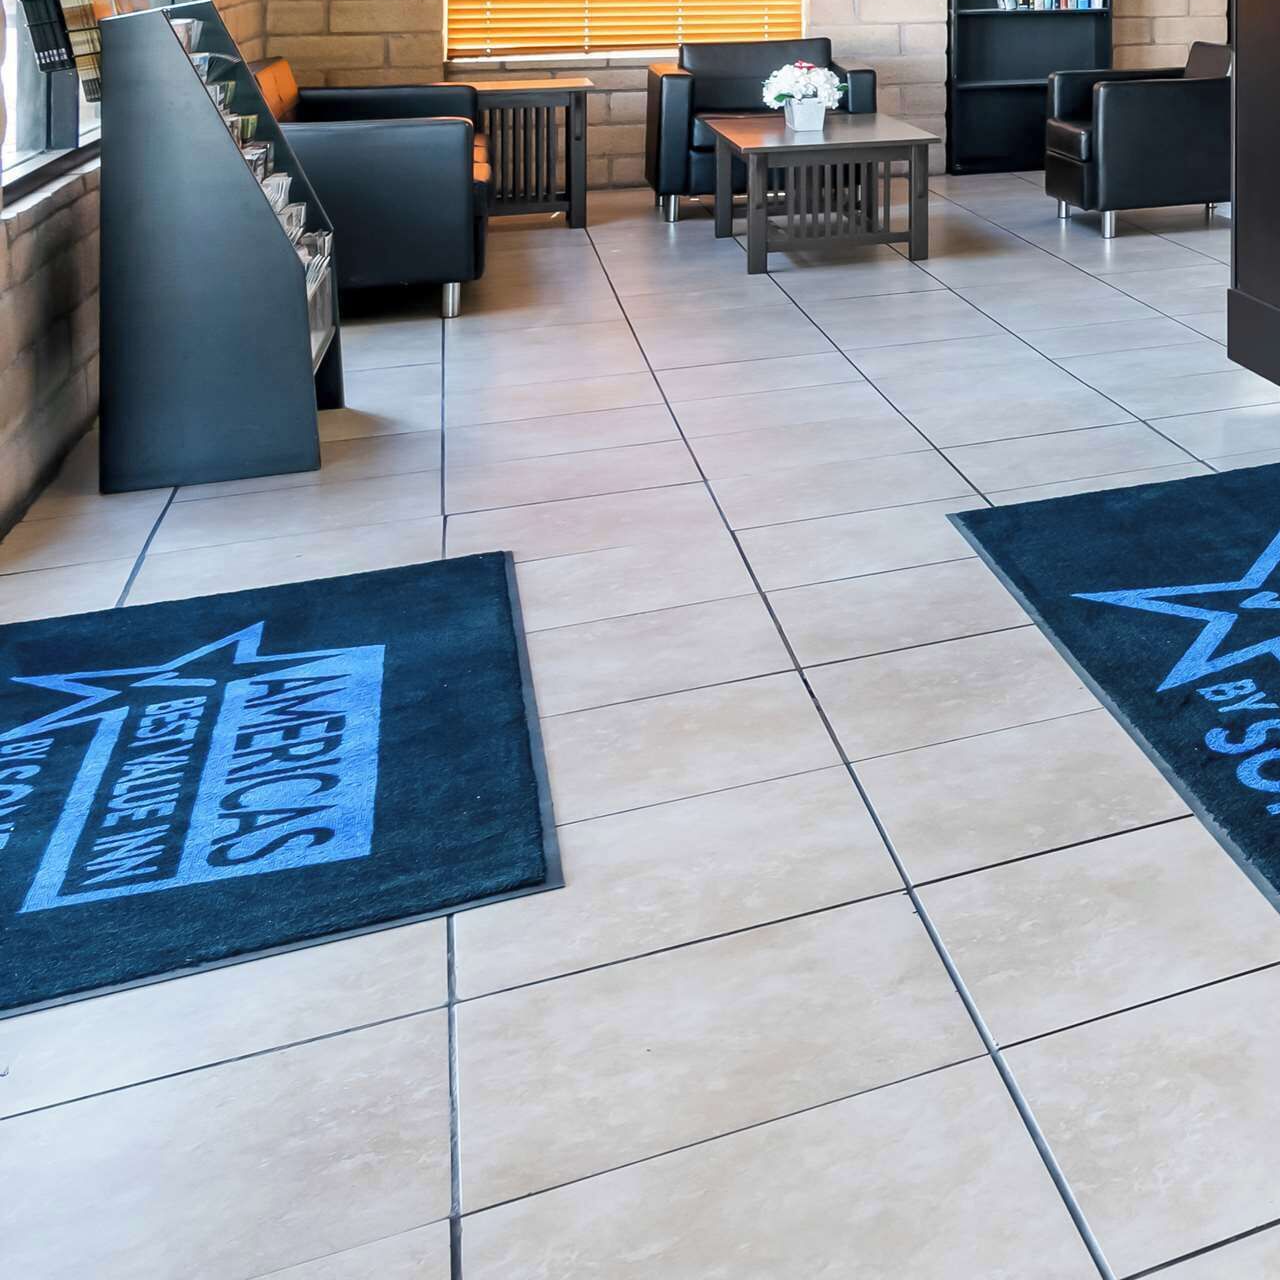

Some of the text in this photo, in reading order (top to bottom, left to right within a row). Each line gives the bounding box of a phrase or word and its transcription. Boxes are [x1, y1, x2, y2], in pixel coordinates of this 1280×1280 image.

[79, 695, 208, 886] BEST VALUE INN
[206, 673, 353, 868] AMERICAS
[1196, 678, 1280, 713] BY
